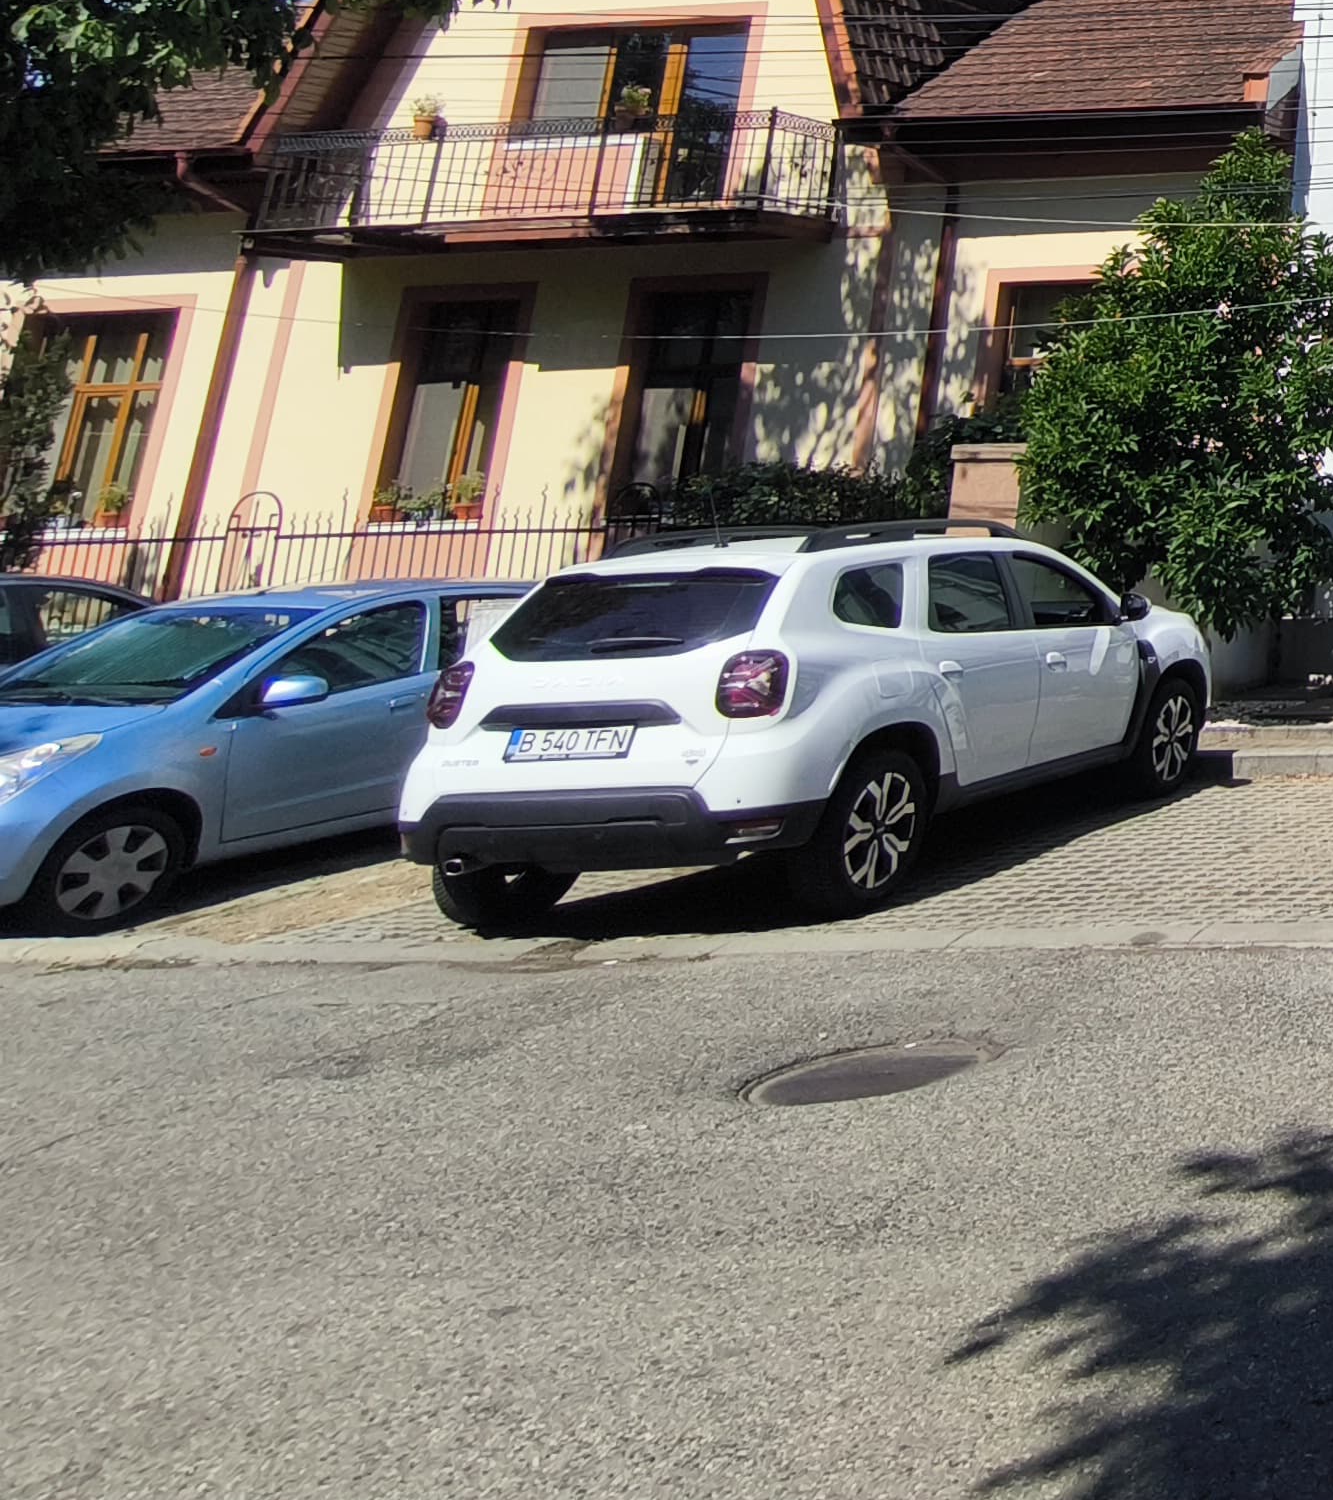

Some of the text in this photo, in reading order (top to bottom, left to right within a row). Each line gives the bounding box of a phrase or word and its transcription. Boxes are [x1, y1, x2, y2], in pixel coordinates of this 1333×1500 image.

[518, 728, 629, 753] B 540 TFN
